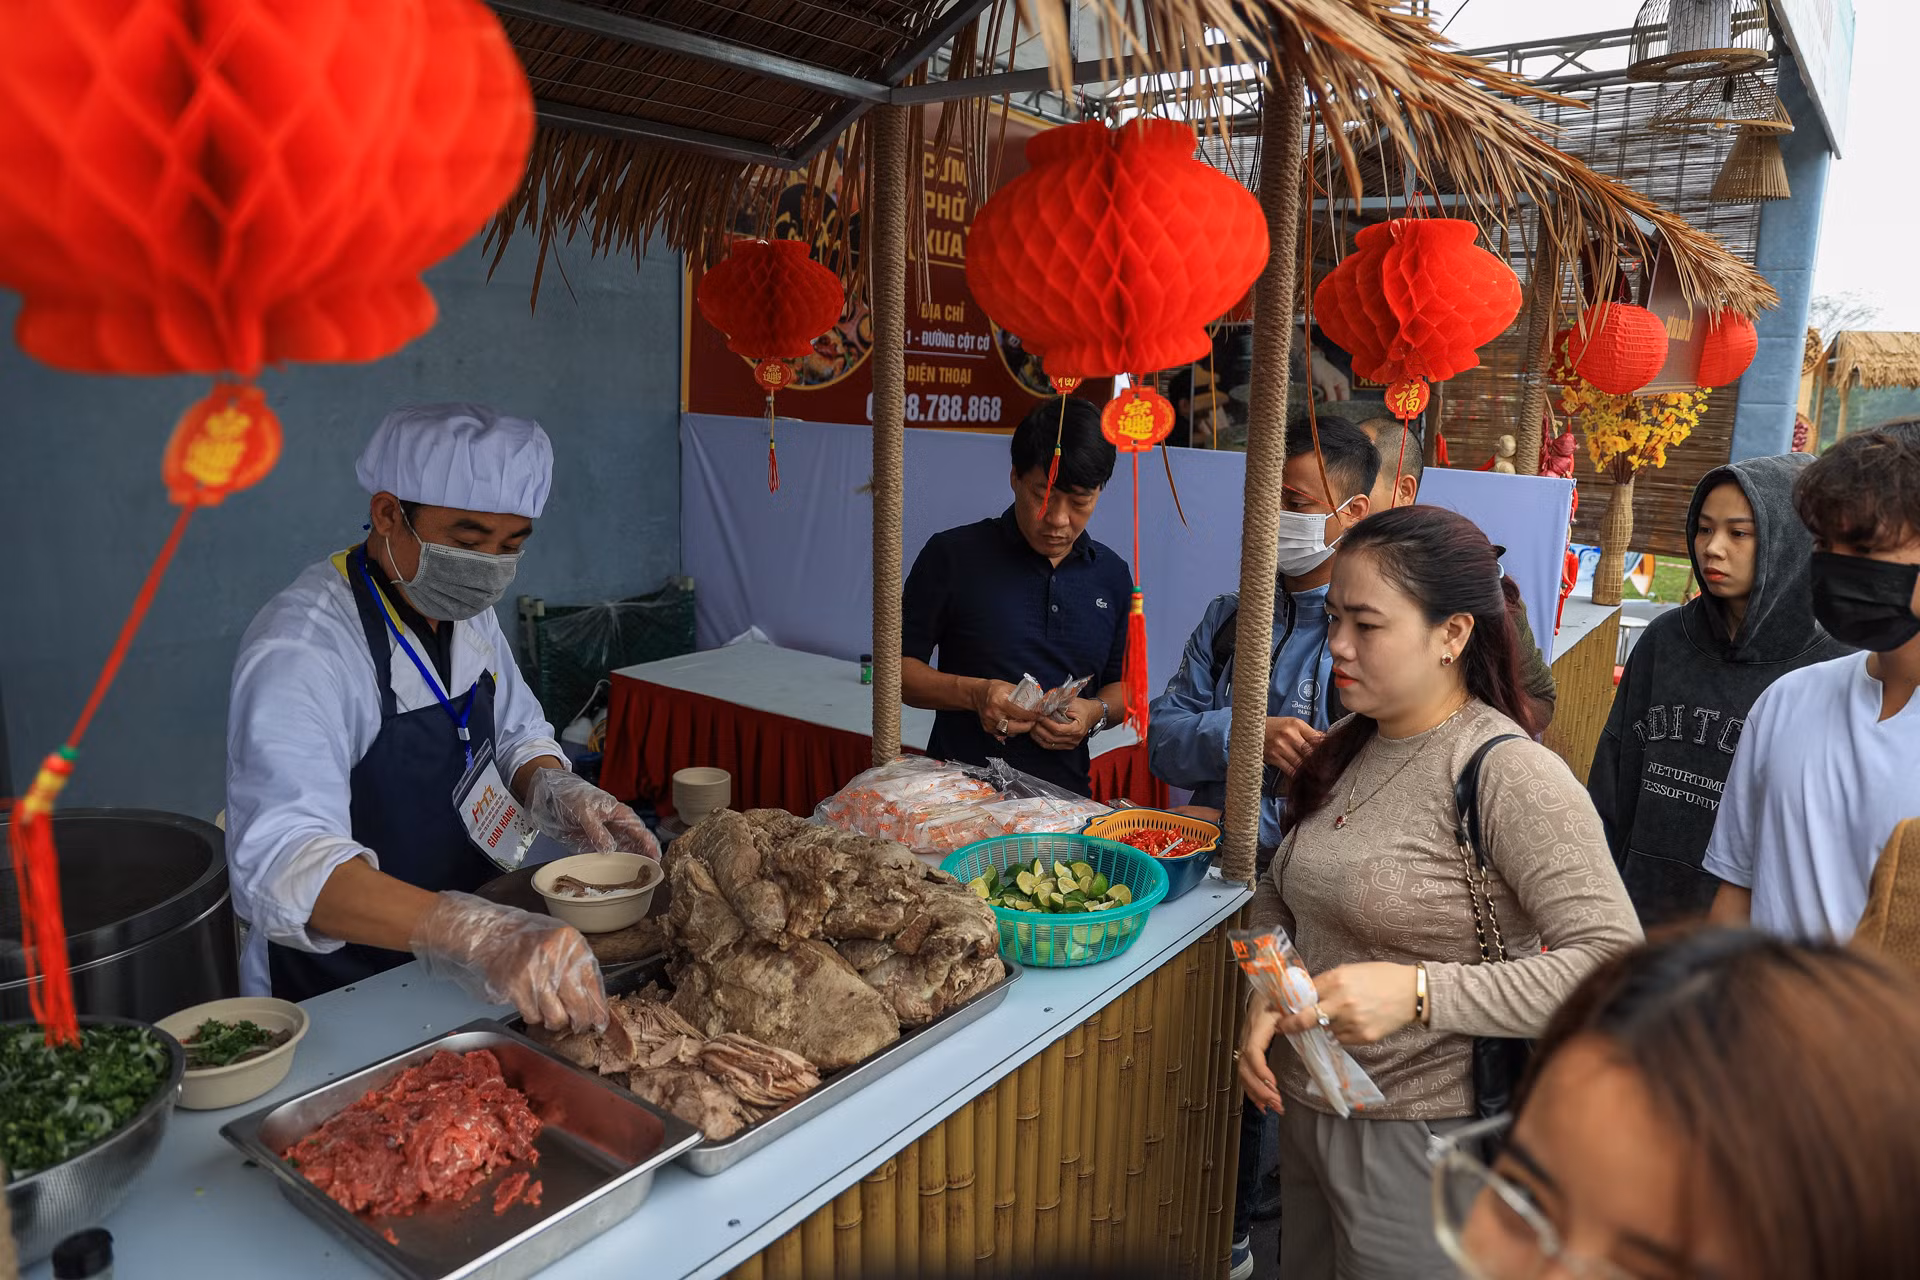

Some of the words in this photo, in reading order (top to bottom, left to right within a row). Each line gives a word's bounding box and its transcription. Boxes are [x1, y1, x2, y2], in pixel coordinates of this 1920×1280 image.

[925, 190, 966, 221] PHỞ
[945, 302, 964, 322] CHỈ
[921, 329, 955, 348] ĐƯỜNG
[957, 331, 975, 353] CỘT
[907, 362, 936, 386] ĐIỆN
[939, 366, 972, 388] THOẠI
[1394, 383, 1421, 413] 福
[487, 826, 503, 848] GIAN
[499, 805, 517, 829] HÀNG
